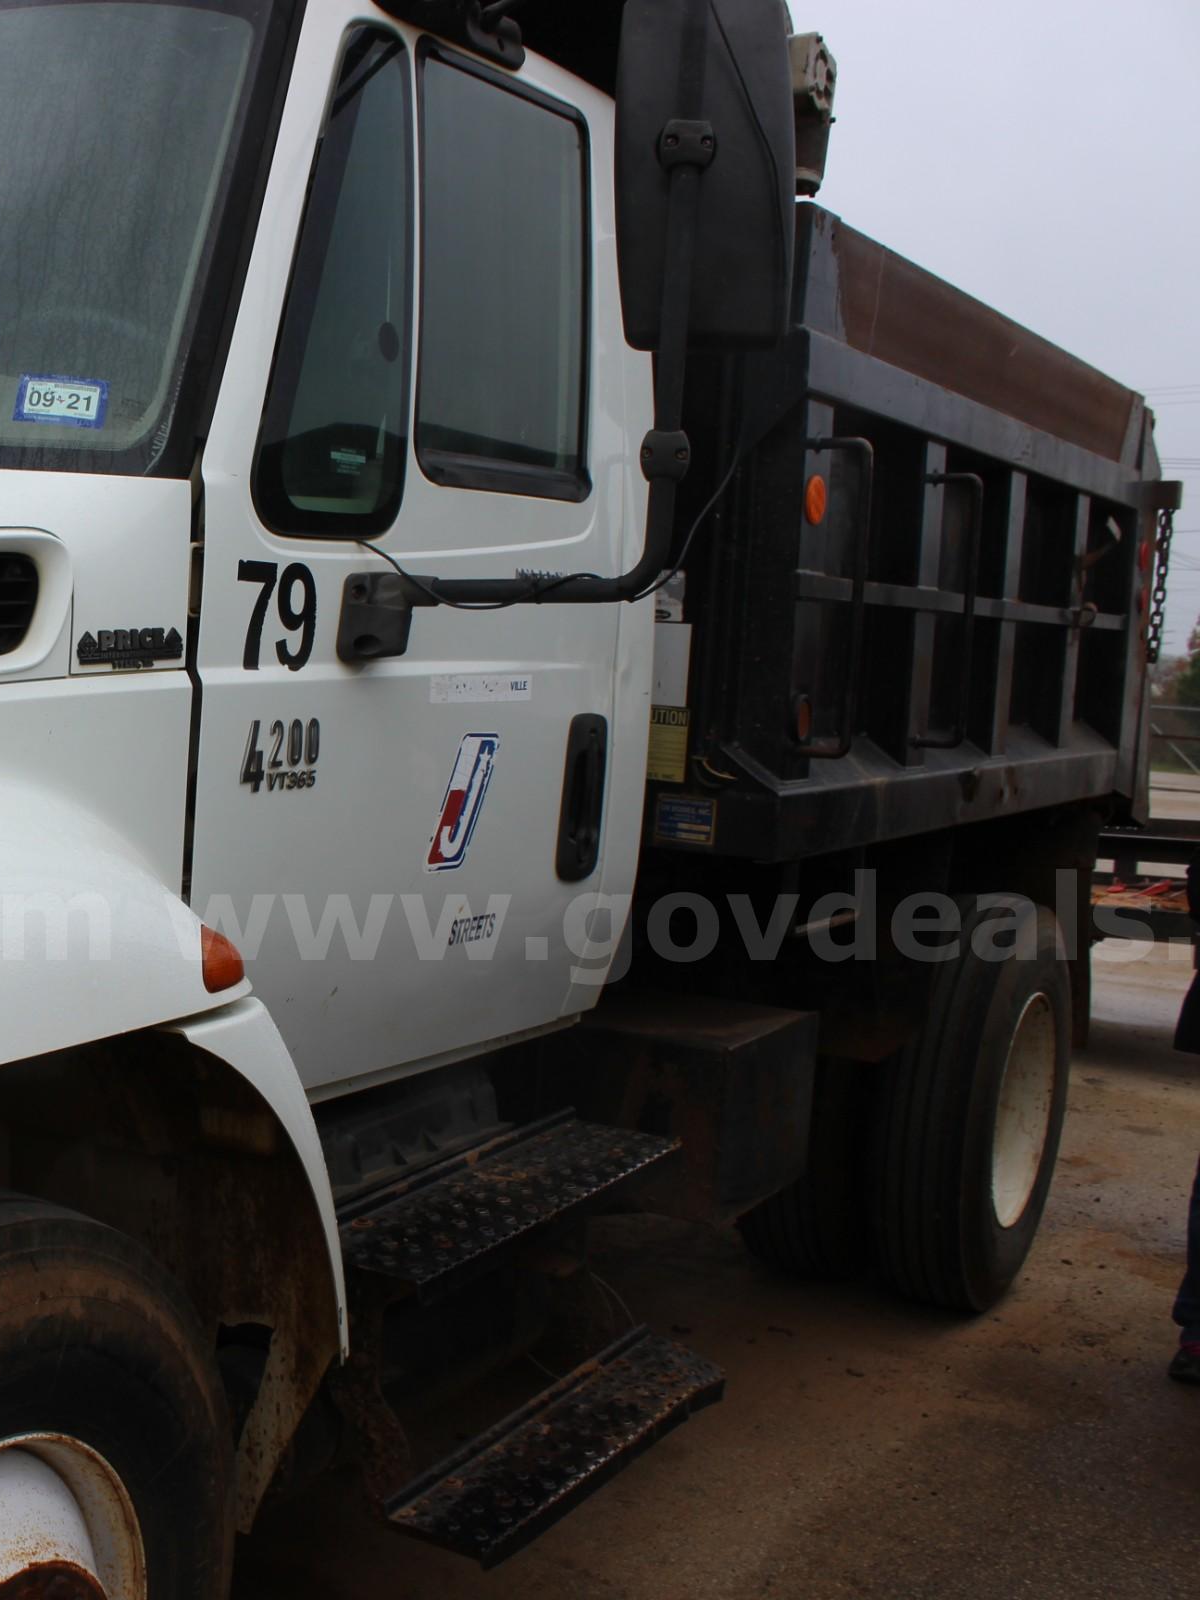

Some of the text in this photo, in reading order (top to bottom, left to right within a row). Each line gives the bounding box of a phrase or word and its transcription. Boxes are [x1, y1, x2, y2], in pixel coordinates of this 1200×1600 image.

[29, 390, 92, 412] 09 21
[237, 559, 317, 672] 79
[97, 627, 166, 651] PRICE
[239, 717, 320, 793] 4200
[266, 769, 317, 792] VT365
[448, 912, 496, 946] STREETS
